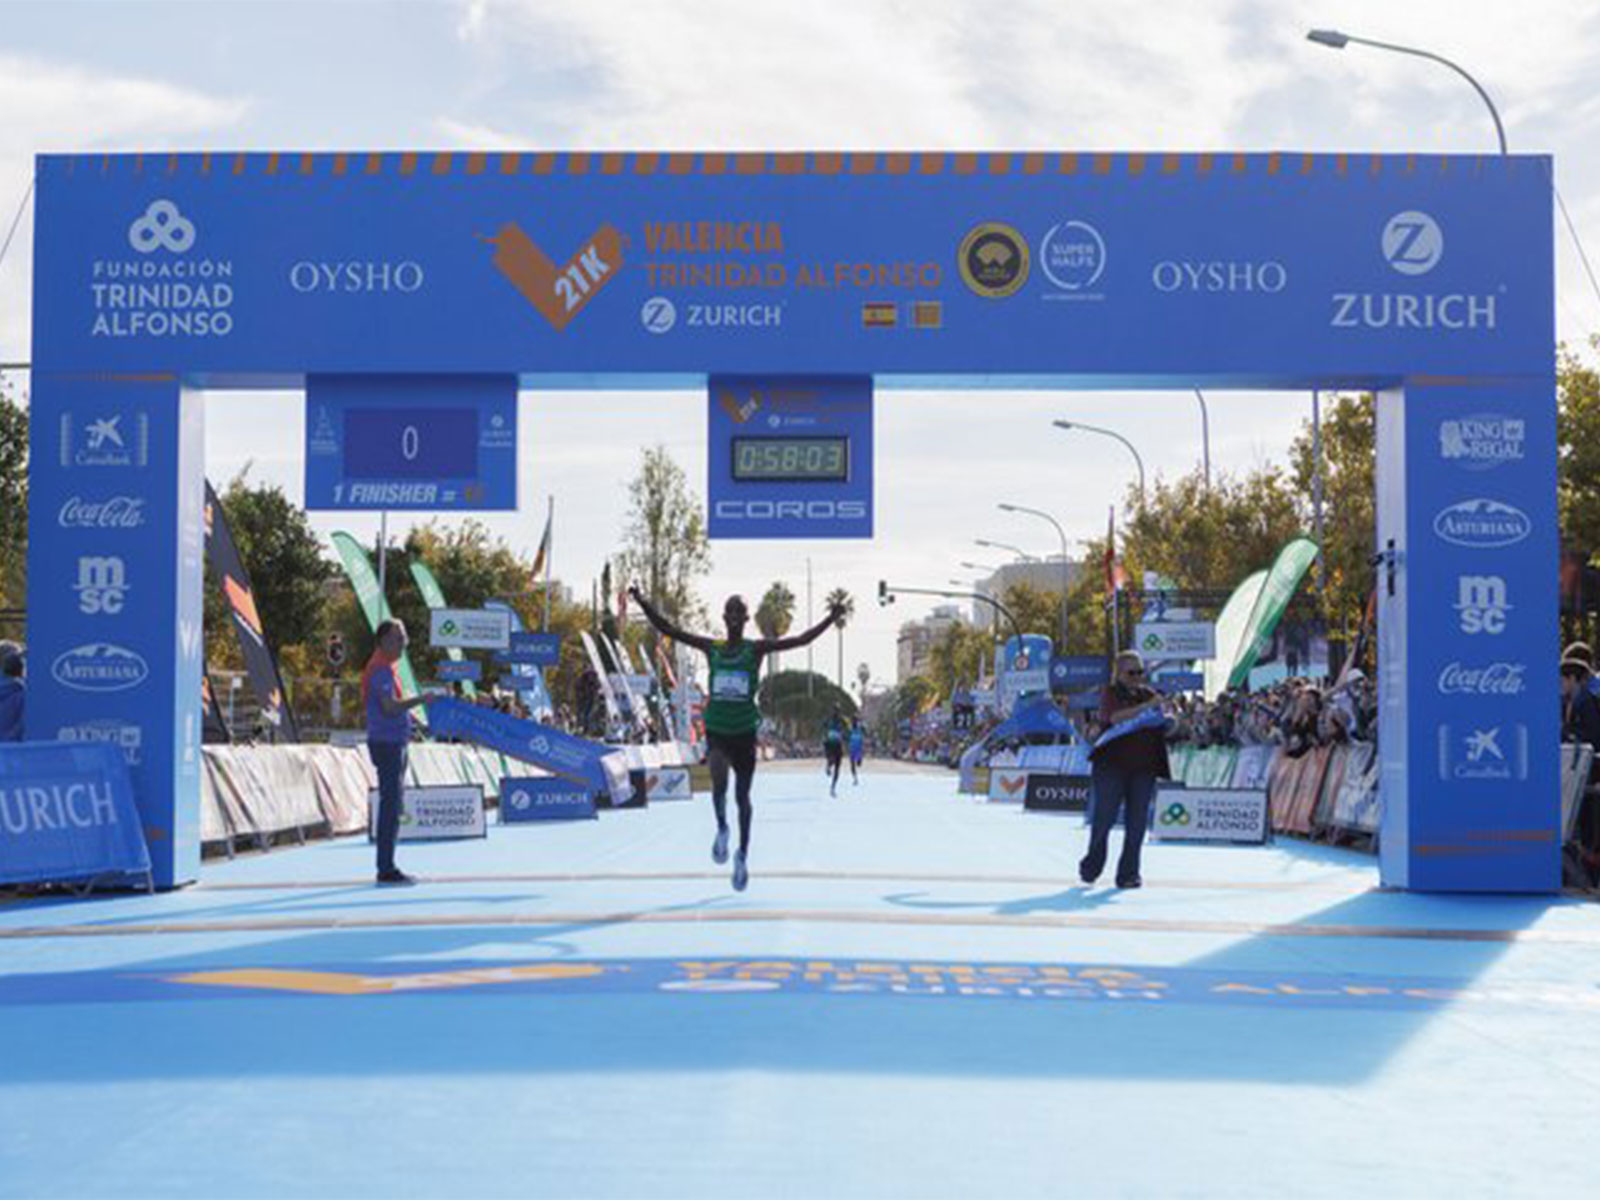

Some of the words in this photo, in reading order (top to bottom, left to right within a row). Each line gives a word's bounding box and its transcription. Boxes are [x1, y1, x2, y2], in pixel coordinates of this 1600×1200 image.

[645, 221, 783, 252] VALENCIA
[92, 259, 233, 277] FUNDACIÓN
[290, 261, 424, 292] OYSHO
[555, 244, 611, 311] 21K
[646, 263, 787, 289] TRINIDAD
[795, 263, 942, 289] ALFONSO
[1152, 261, 1287, 293] OYSHO
[92, 283, 233, 308] TRINIDAD
[92, 311, 233, 336] ALFONSO
[686, 305, 782, 327] ZURICH
[1331, 294, 1497, 329] ZURICH
[402, 425, 419, 460] 0
[1460, 421, 1501, 440] KING
[740, 445, 843, 472] 0:58:03
[1470, 440, 1525, 459] REGAL
[333, 484, 344, 504] 1
[350, 484, 437, 504] FINISHER
[716, 501, 867, 519] COROS
[0, 782, 119, 834] URICH
